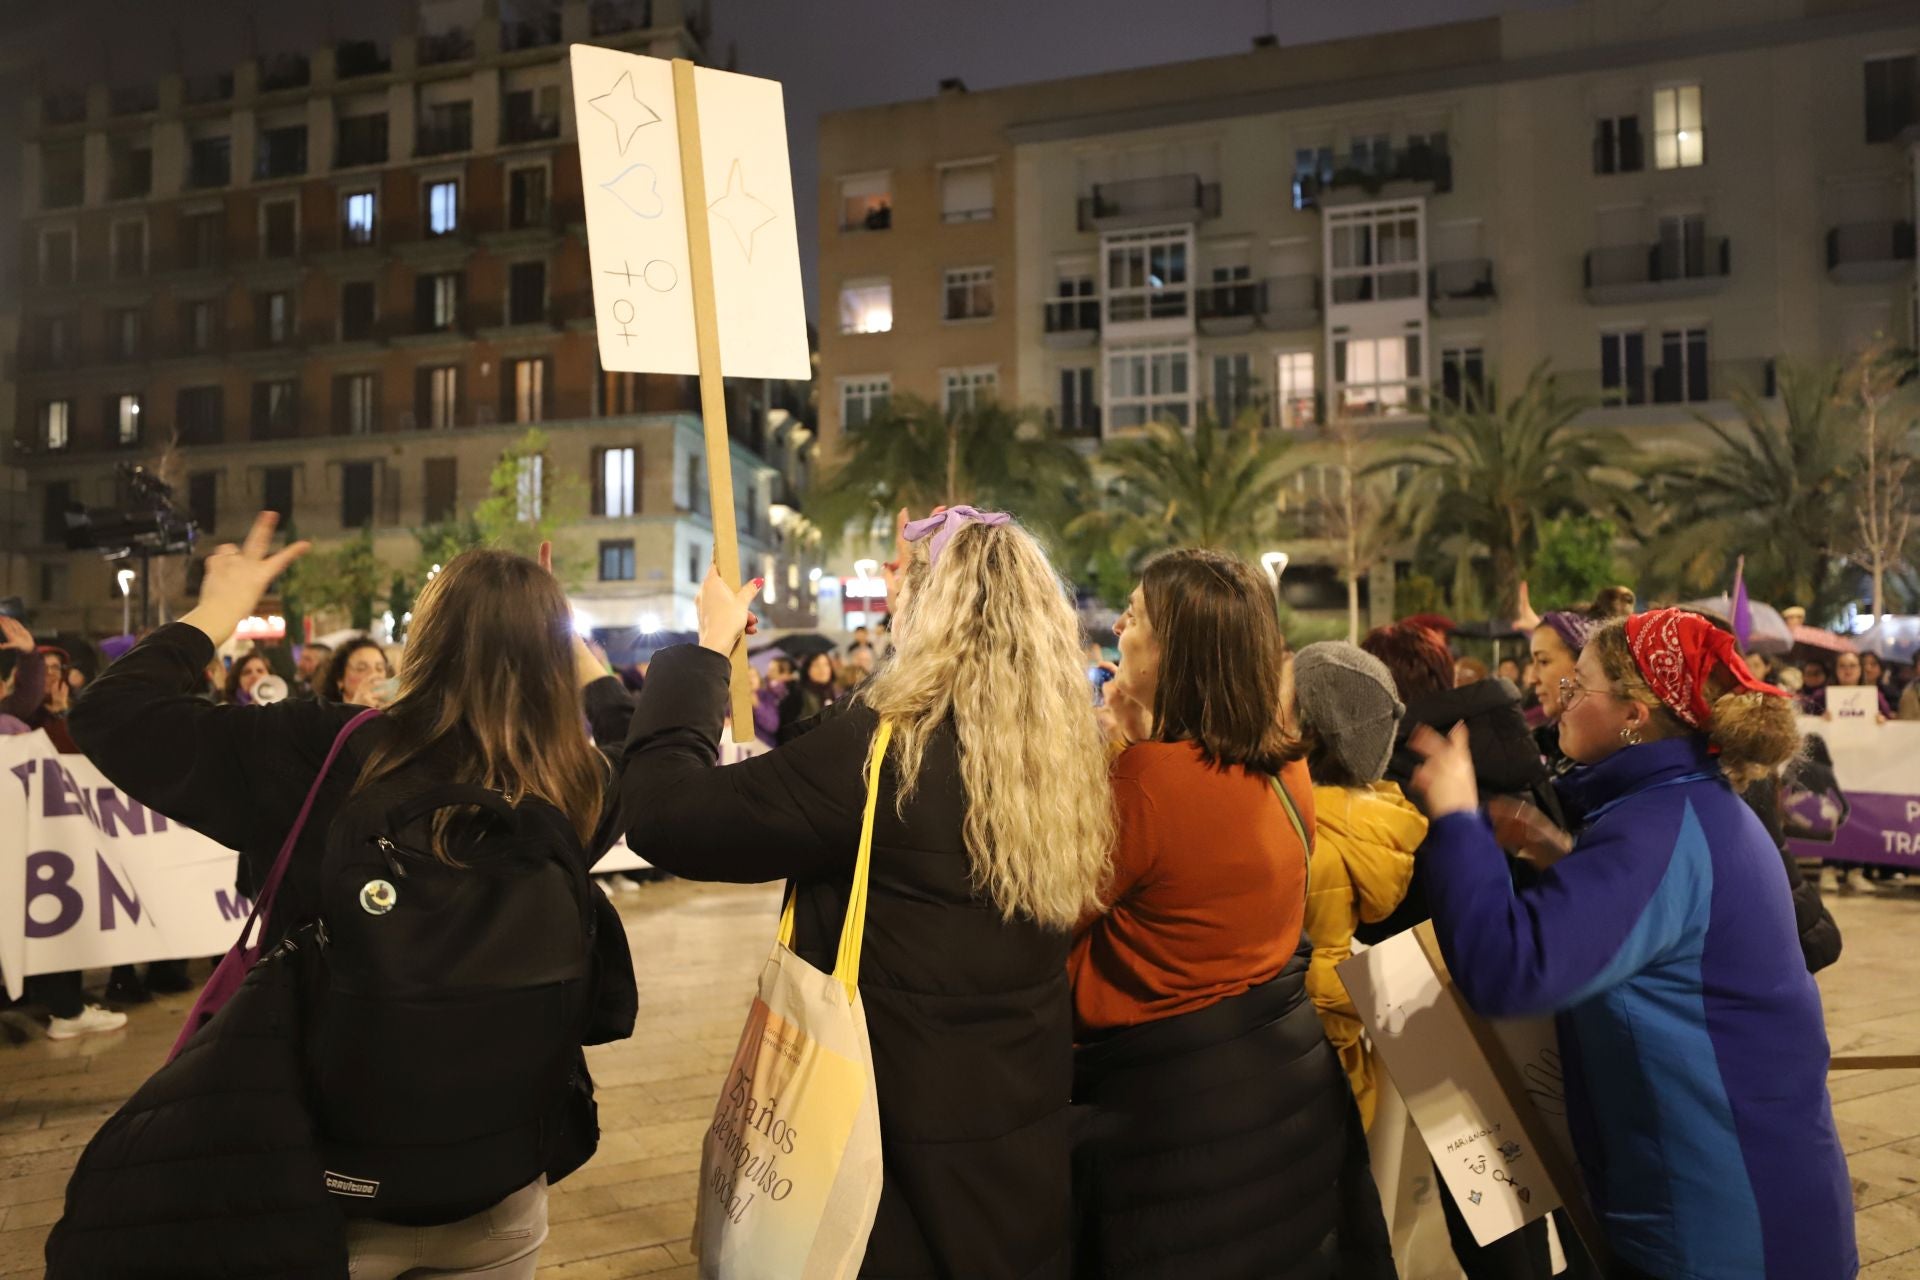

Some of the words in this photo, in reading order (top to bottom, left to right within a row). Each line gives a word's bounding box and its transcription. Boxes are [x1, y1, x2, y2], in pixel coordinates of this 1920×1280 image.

[712, 1106, 729, 1141] de
[729, 1067, 750, 1108] 25
[745, 1097, 797, 1154] años
[711, 1166, 754, 1224] social
